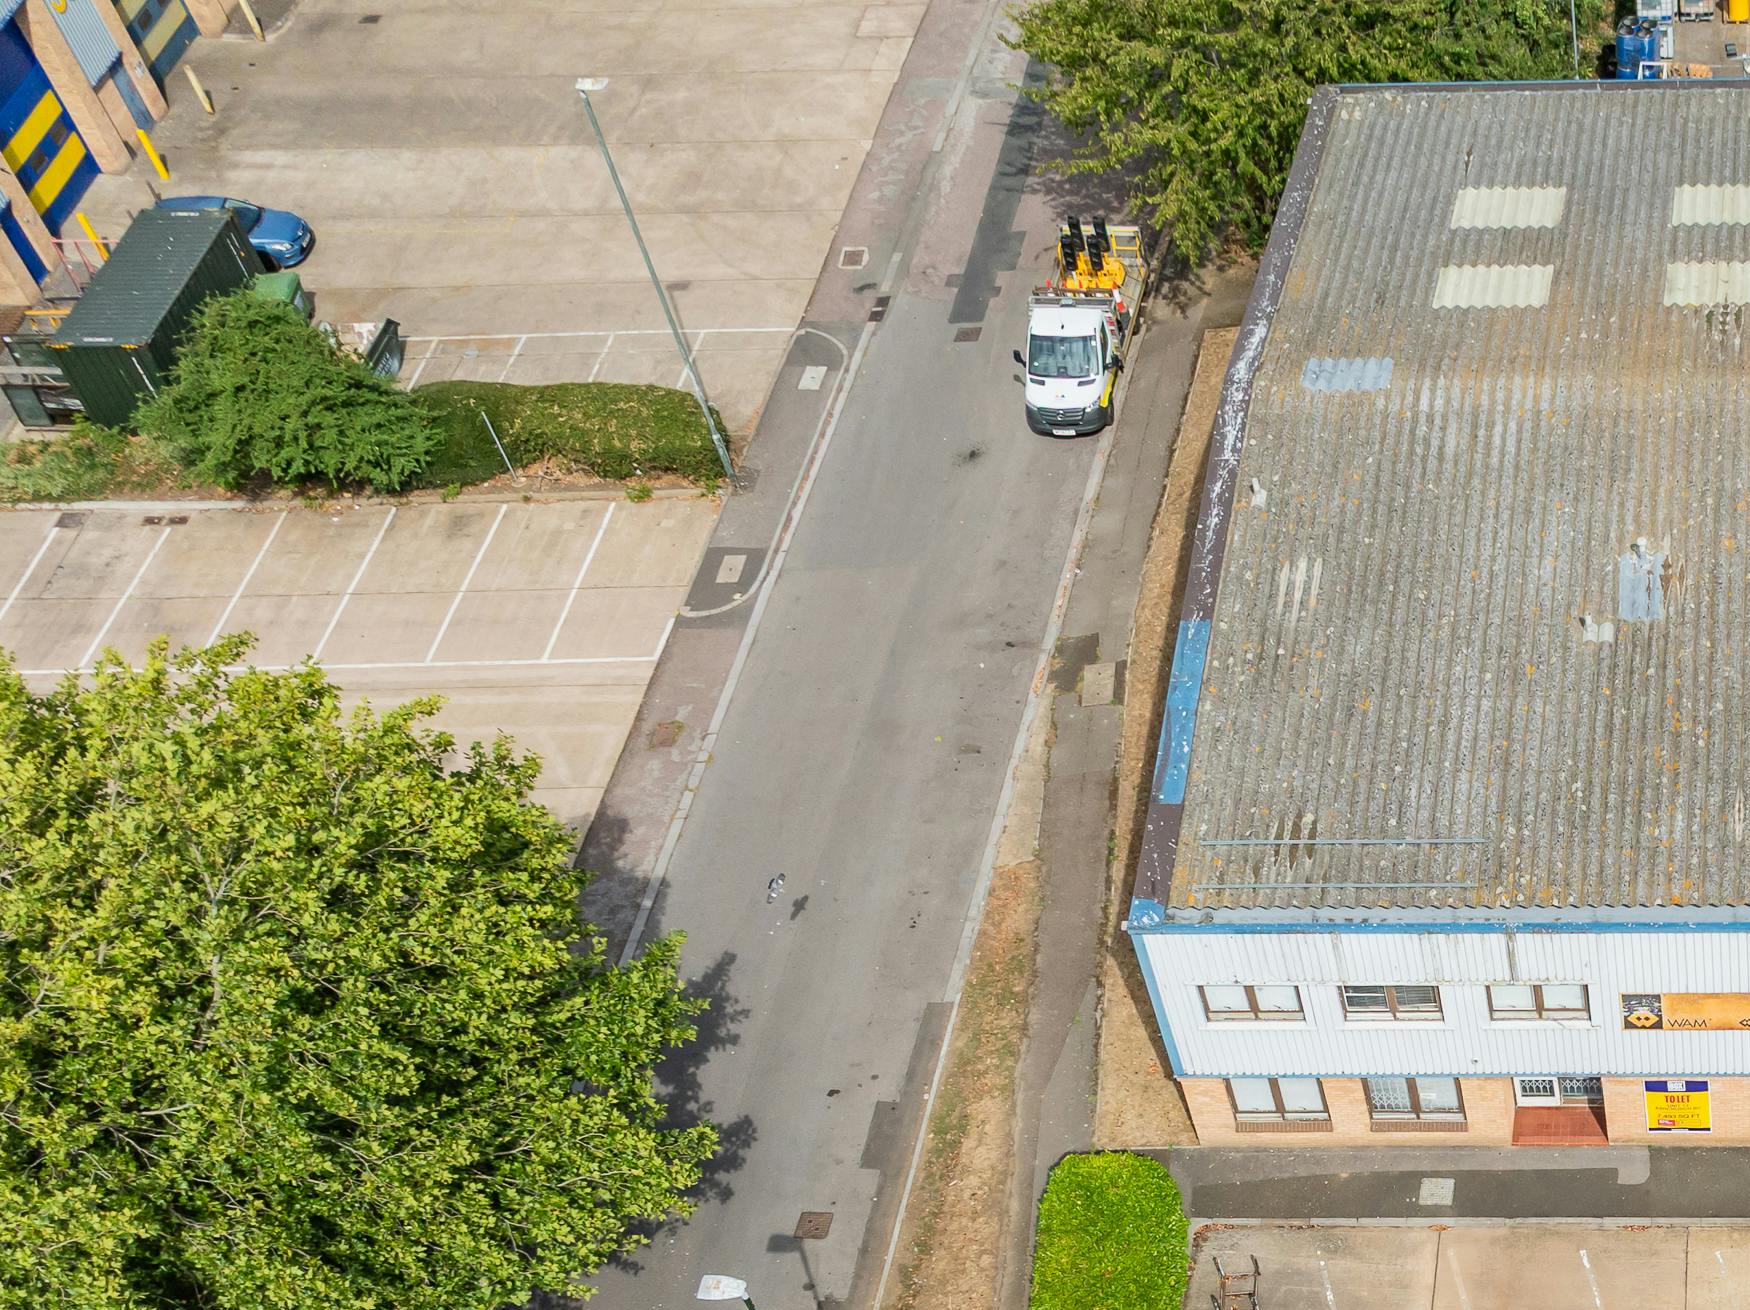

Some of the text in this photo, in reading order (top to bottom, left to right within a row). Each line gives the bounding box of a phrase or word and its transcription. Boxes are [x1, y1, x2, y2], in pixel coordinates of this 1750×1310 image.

[1667, 1018, 1708, 1028] WAM
[1665, 1095, 1690, 1103] TO LET
